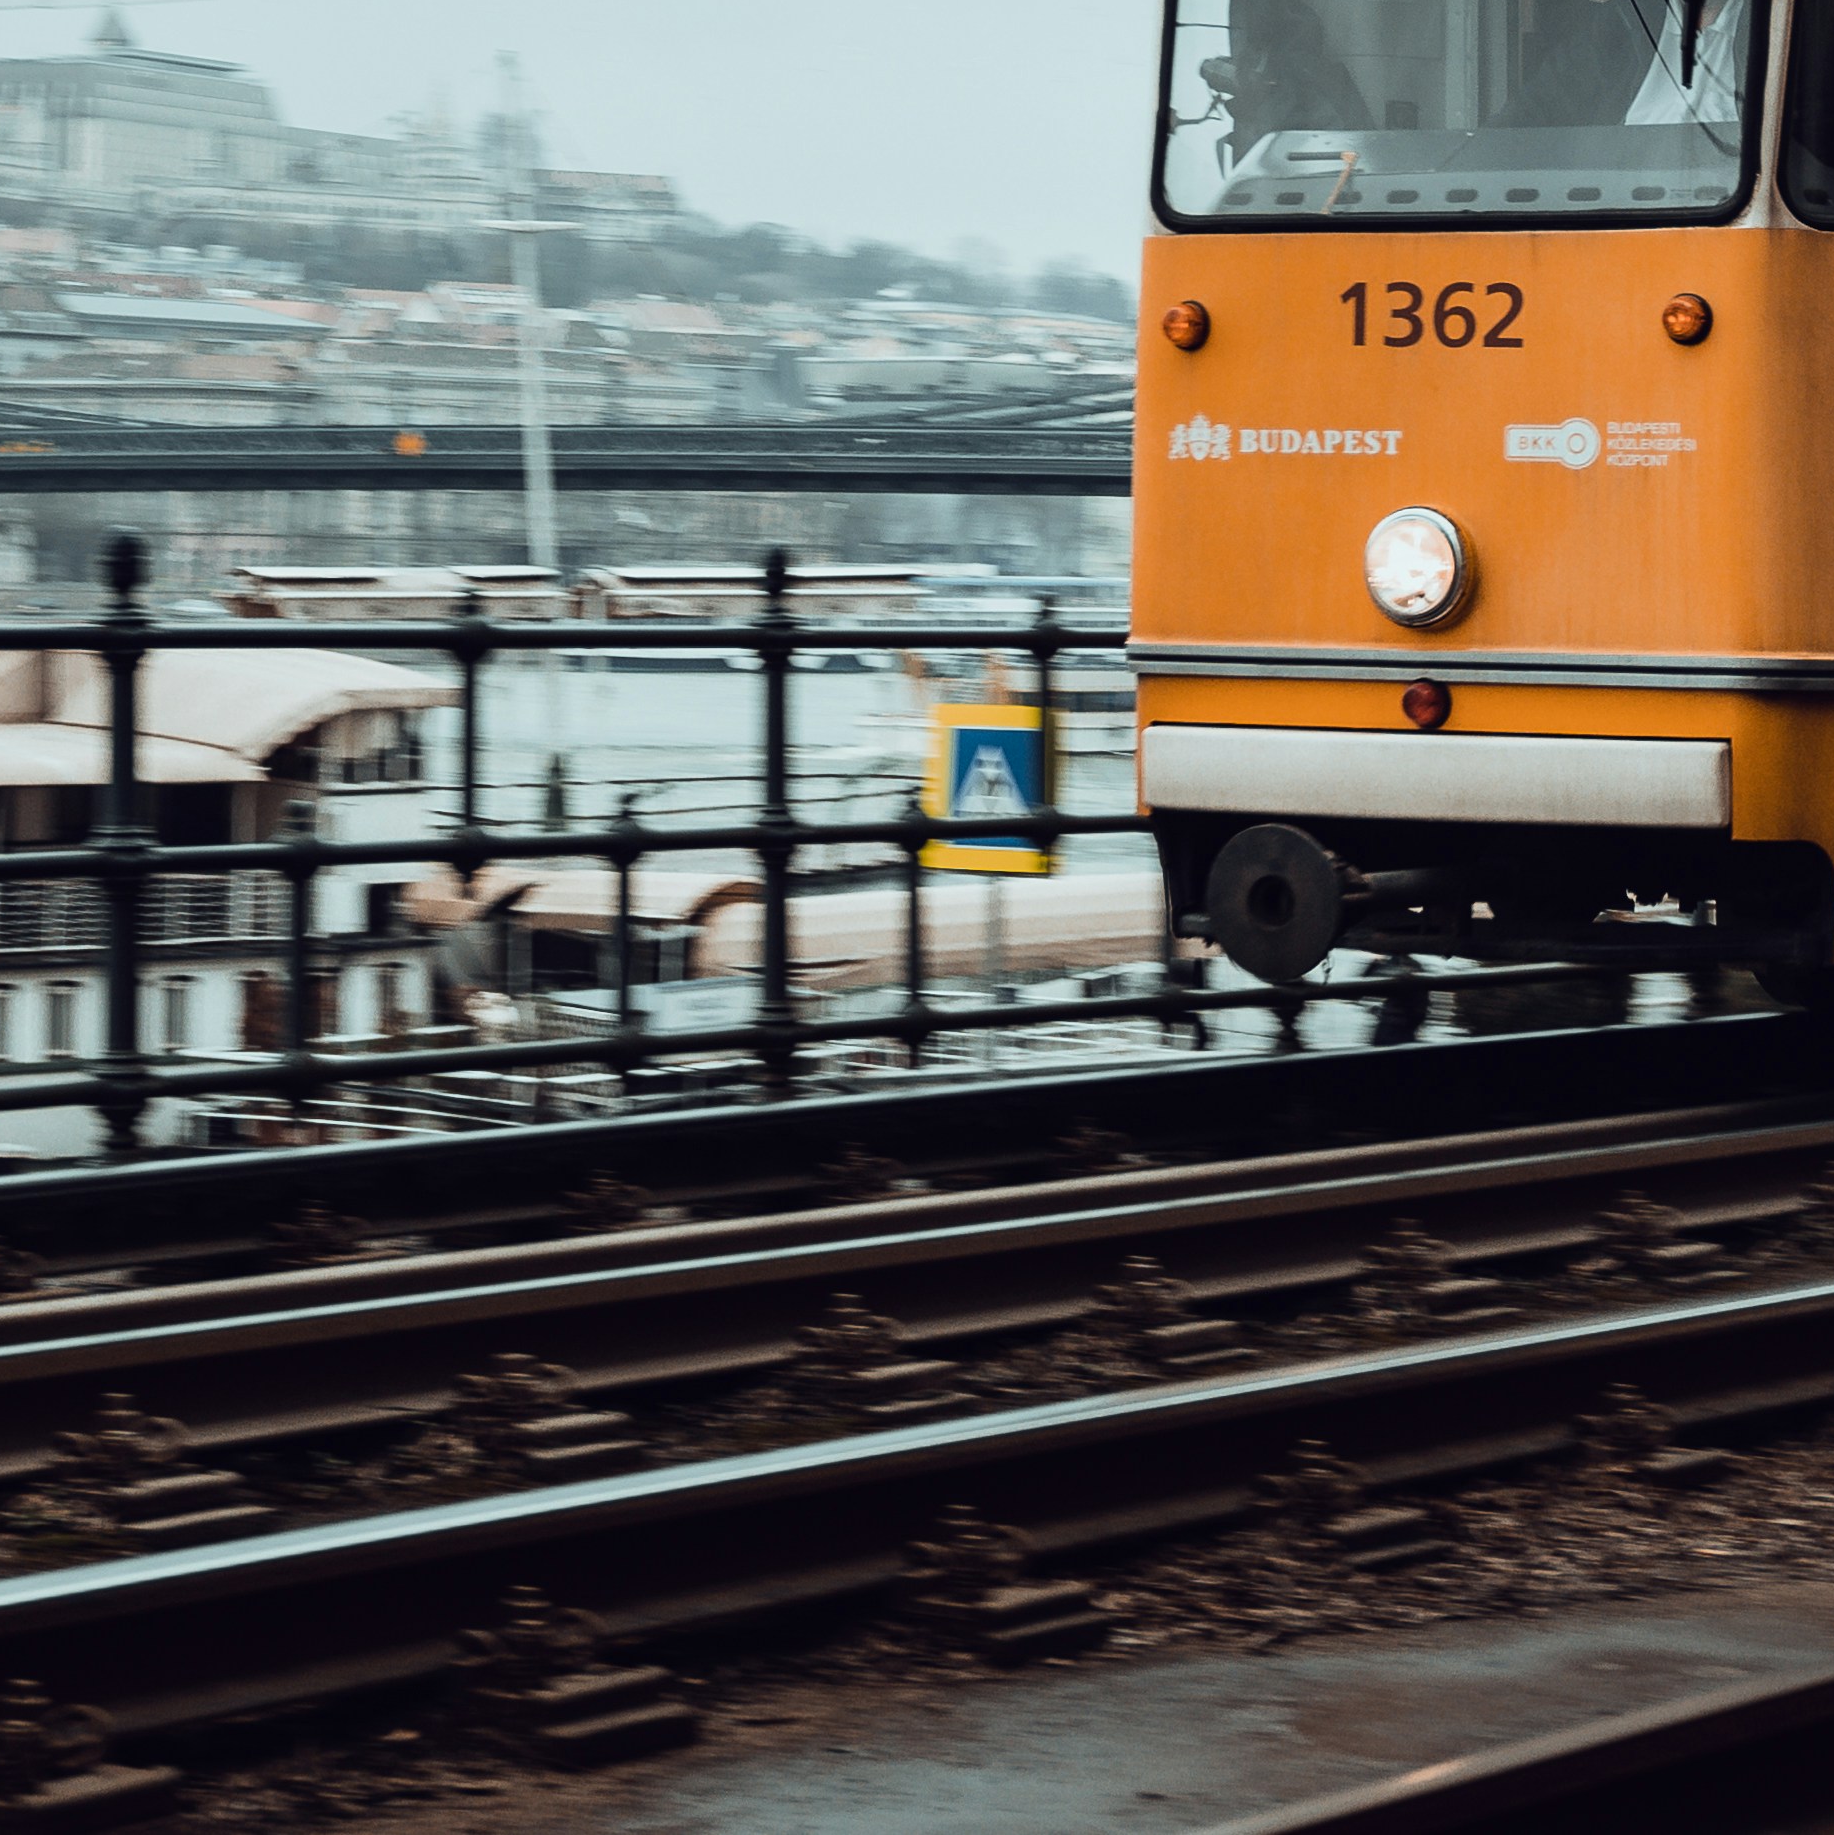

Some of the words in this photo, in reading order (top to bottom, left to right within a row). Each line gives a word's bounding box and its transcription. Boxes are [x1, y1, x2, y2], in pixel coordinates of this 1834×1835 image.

[1340, 281, 1523, 348] 1362
[1606, 422, 1681, 434] BUDAPESTI
[1239, 429, 1403, 455] BUDAPEST
[1518, 436, 1557, 450] BKK
[1606, 453, 1668, 466] KÖZPONT
